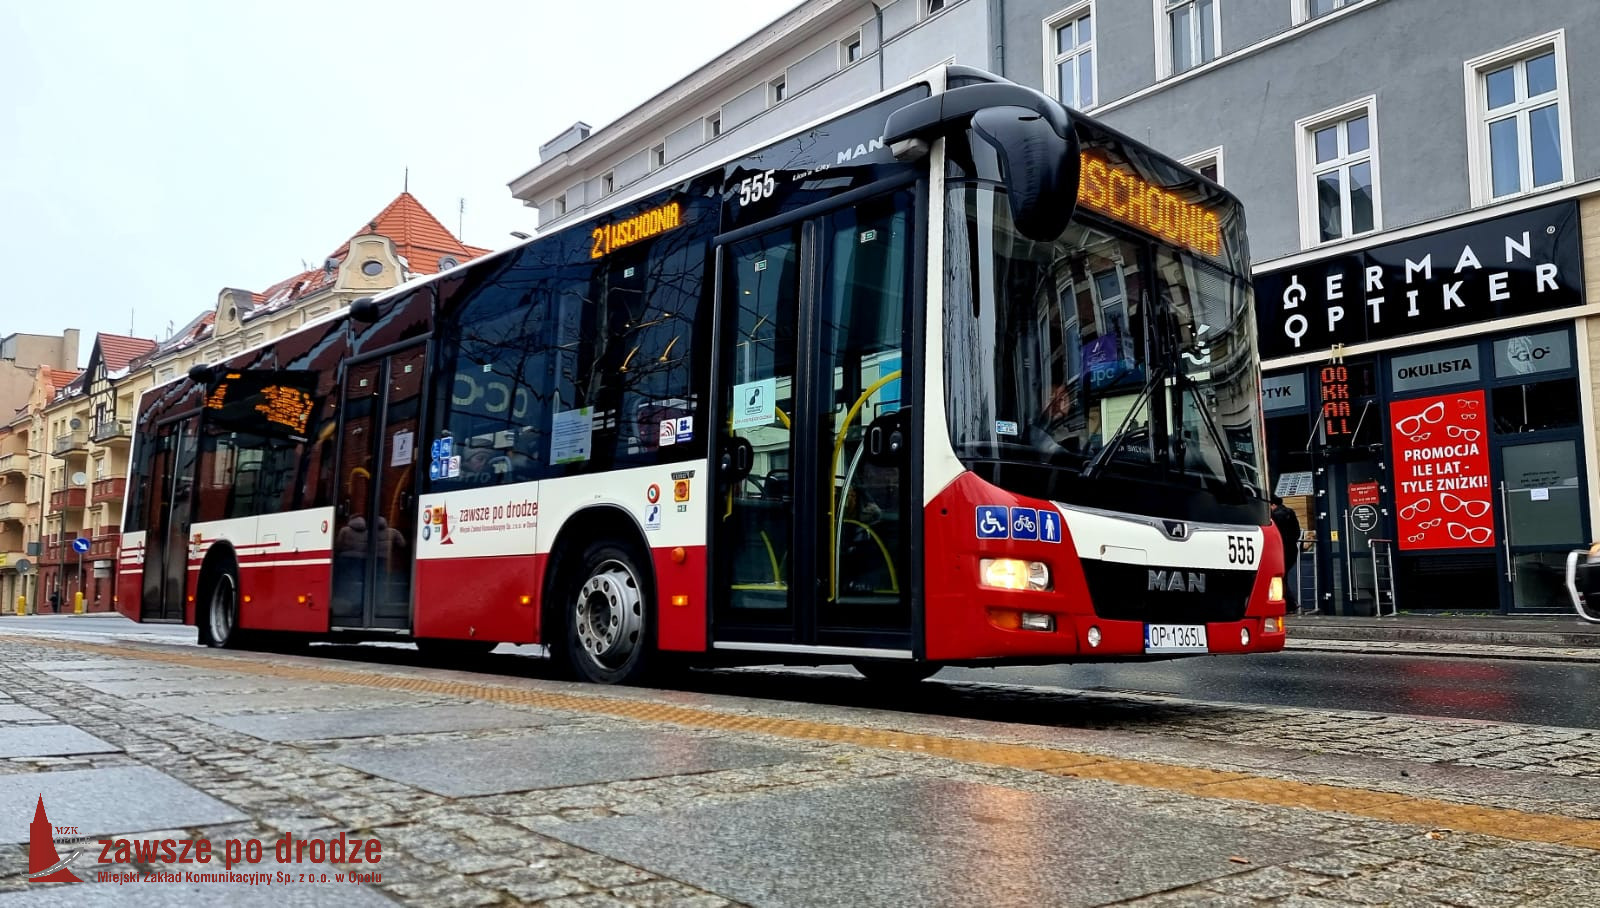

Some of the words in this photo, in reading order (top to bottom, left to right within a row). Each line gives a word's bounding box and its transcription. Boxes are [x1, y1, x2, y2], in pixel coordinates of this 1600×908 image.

[837, 136, 884, 165] MAN
[739, 169, 776, 207] 555
[591, 223, 611, 259] 21
[611, 202, 680, 250] WSCHODNIA
[1282, 231, 1531, 310] GERMAN
[1284, 262, 1560, 348] OPTIKER
[1397, 358, 1472, 379] OKULISTA
[1404, 443, 1479, 462] PROMOCJA
[1412, 464, 1433, 477] ILE
[1436, 461, 1461, 475] LAT
[1401, 481, 1433, 494] TYLE
[1436, 474, 1489, 491] ZNIŻKI!
[459, 506, 490, 523] zawsze
[492, 505, 503, 524] po
[506, 498, 539, 519] drodze
[1227, 534, 1255, 565] 555
[1147, 569, 1206, 592] MAN
